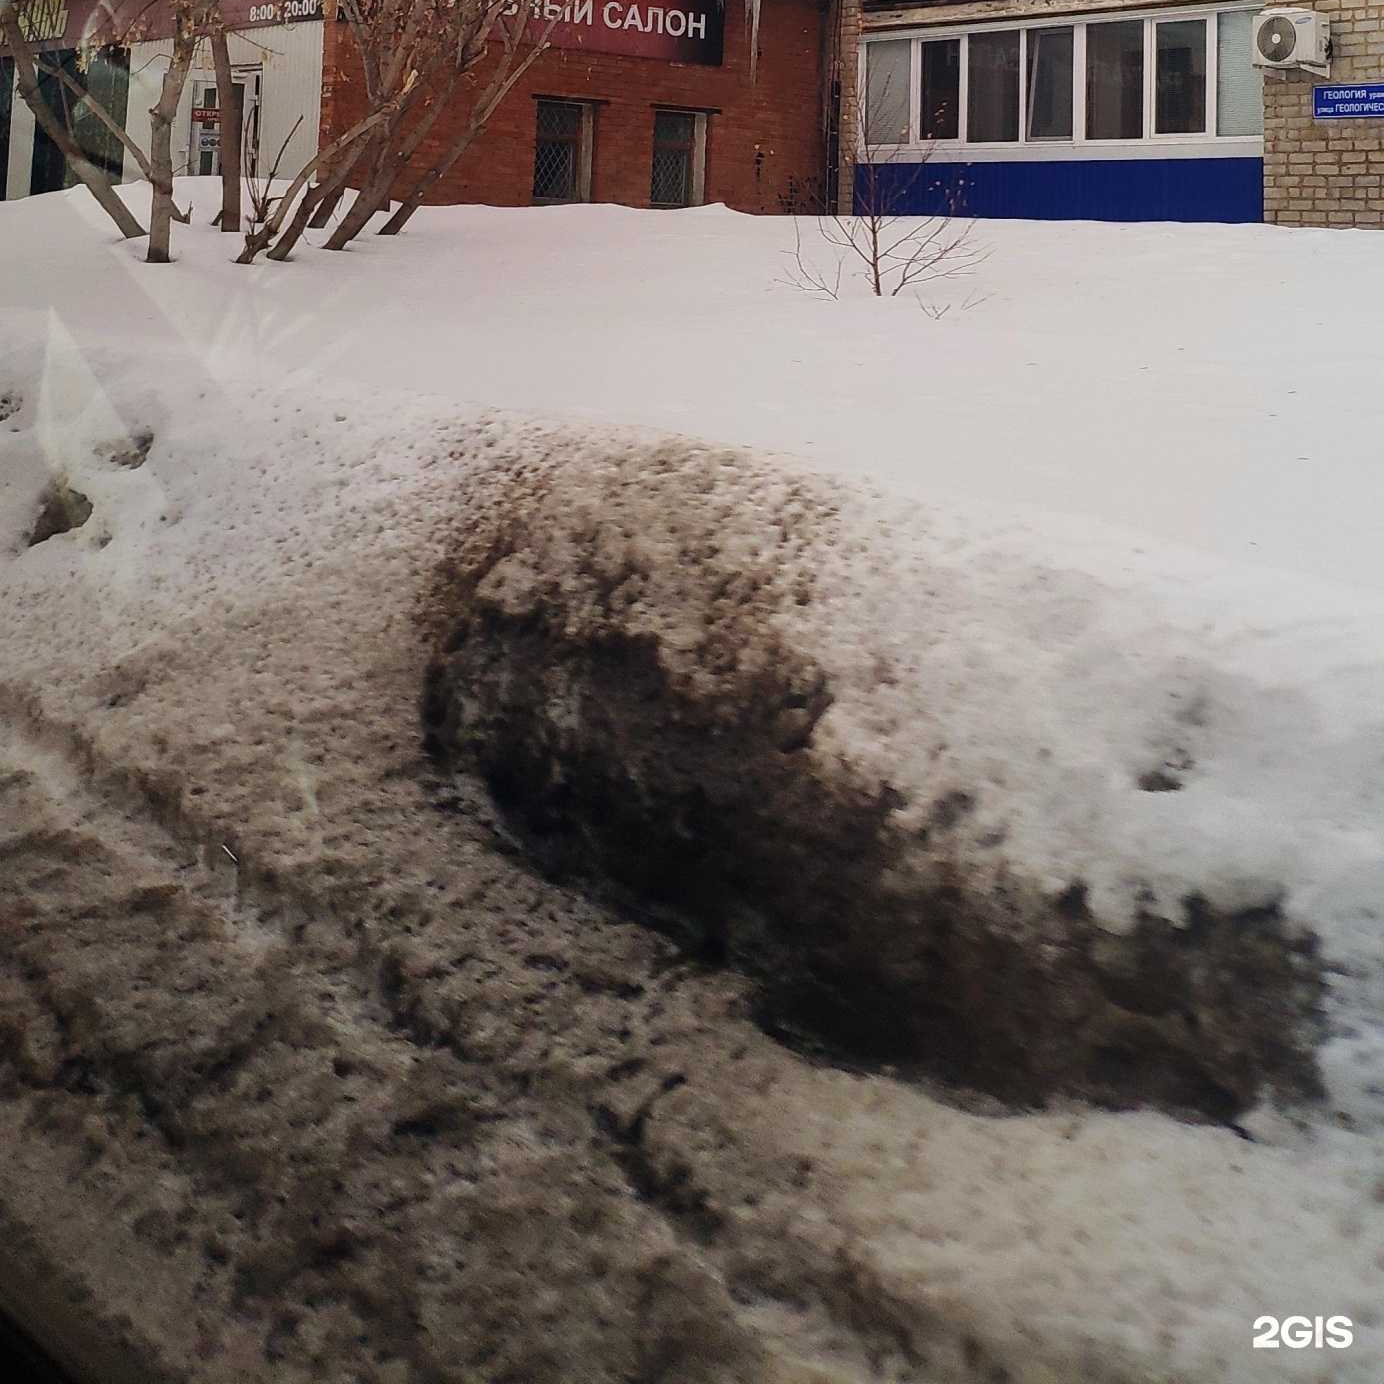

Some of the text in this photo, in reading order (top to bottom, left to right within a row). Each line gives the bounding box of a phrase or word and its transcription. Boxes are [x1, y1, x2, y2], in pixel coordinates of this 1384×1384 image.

[249, 3, 274, 22] 8:00
[602, 2, 707, 39] САЛОН
[1323, 89, 1367, 100] ГЕОЛОГИЯ
